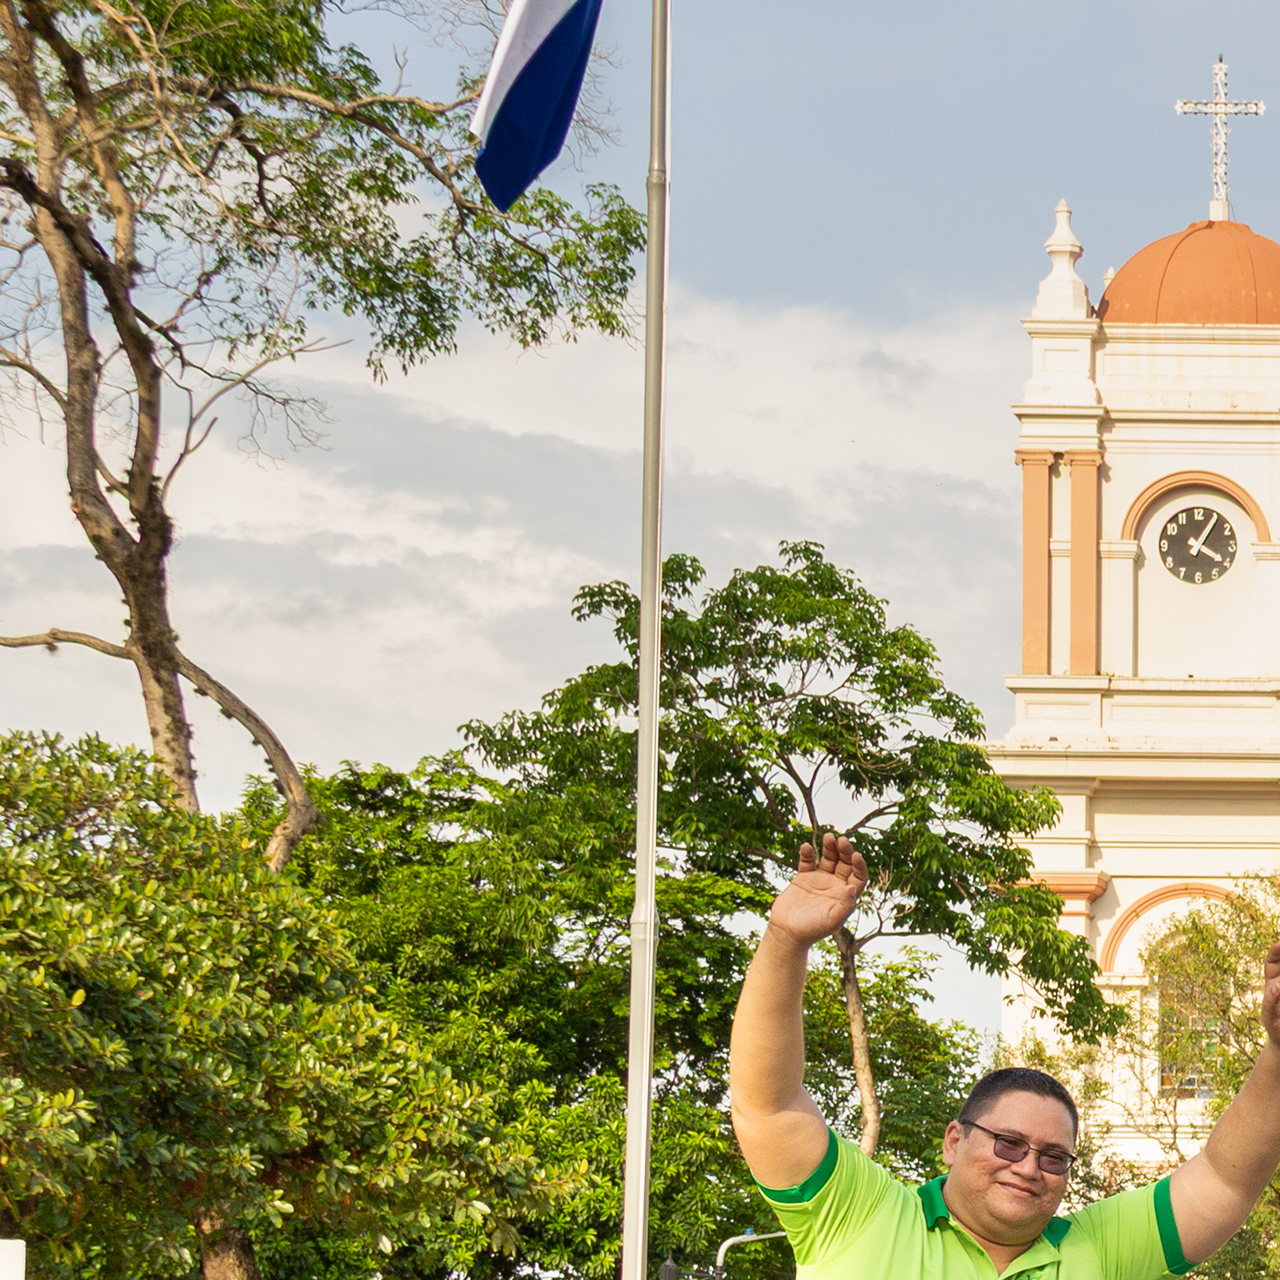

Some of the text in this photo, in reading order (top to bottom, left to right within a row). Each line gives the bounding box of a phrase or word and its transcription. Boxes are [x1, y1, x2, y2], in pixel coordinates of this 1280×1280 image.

[1178, 512, 1187, 525] 11
[1194, 508, 1204, 520] 12
[1167, 523, 1177, 535] 10
[1224, 523, 1231, 535] 2
[1160, 540, 1168, 552] 9
[1228, 541, 1236, 552] 3
[1166, 556, 1173, 568] 8
[1223, 558, 1231, 568] 4
[1180, 567, 1186, 579] 7
[1194, 572, 1202, 584] 6
[1211, 568, 1219, 579] 5
